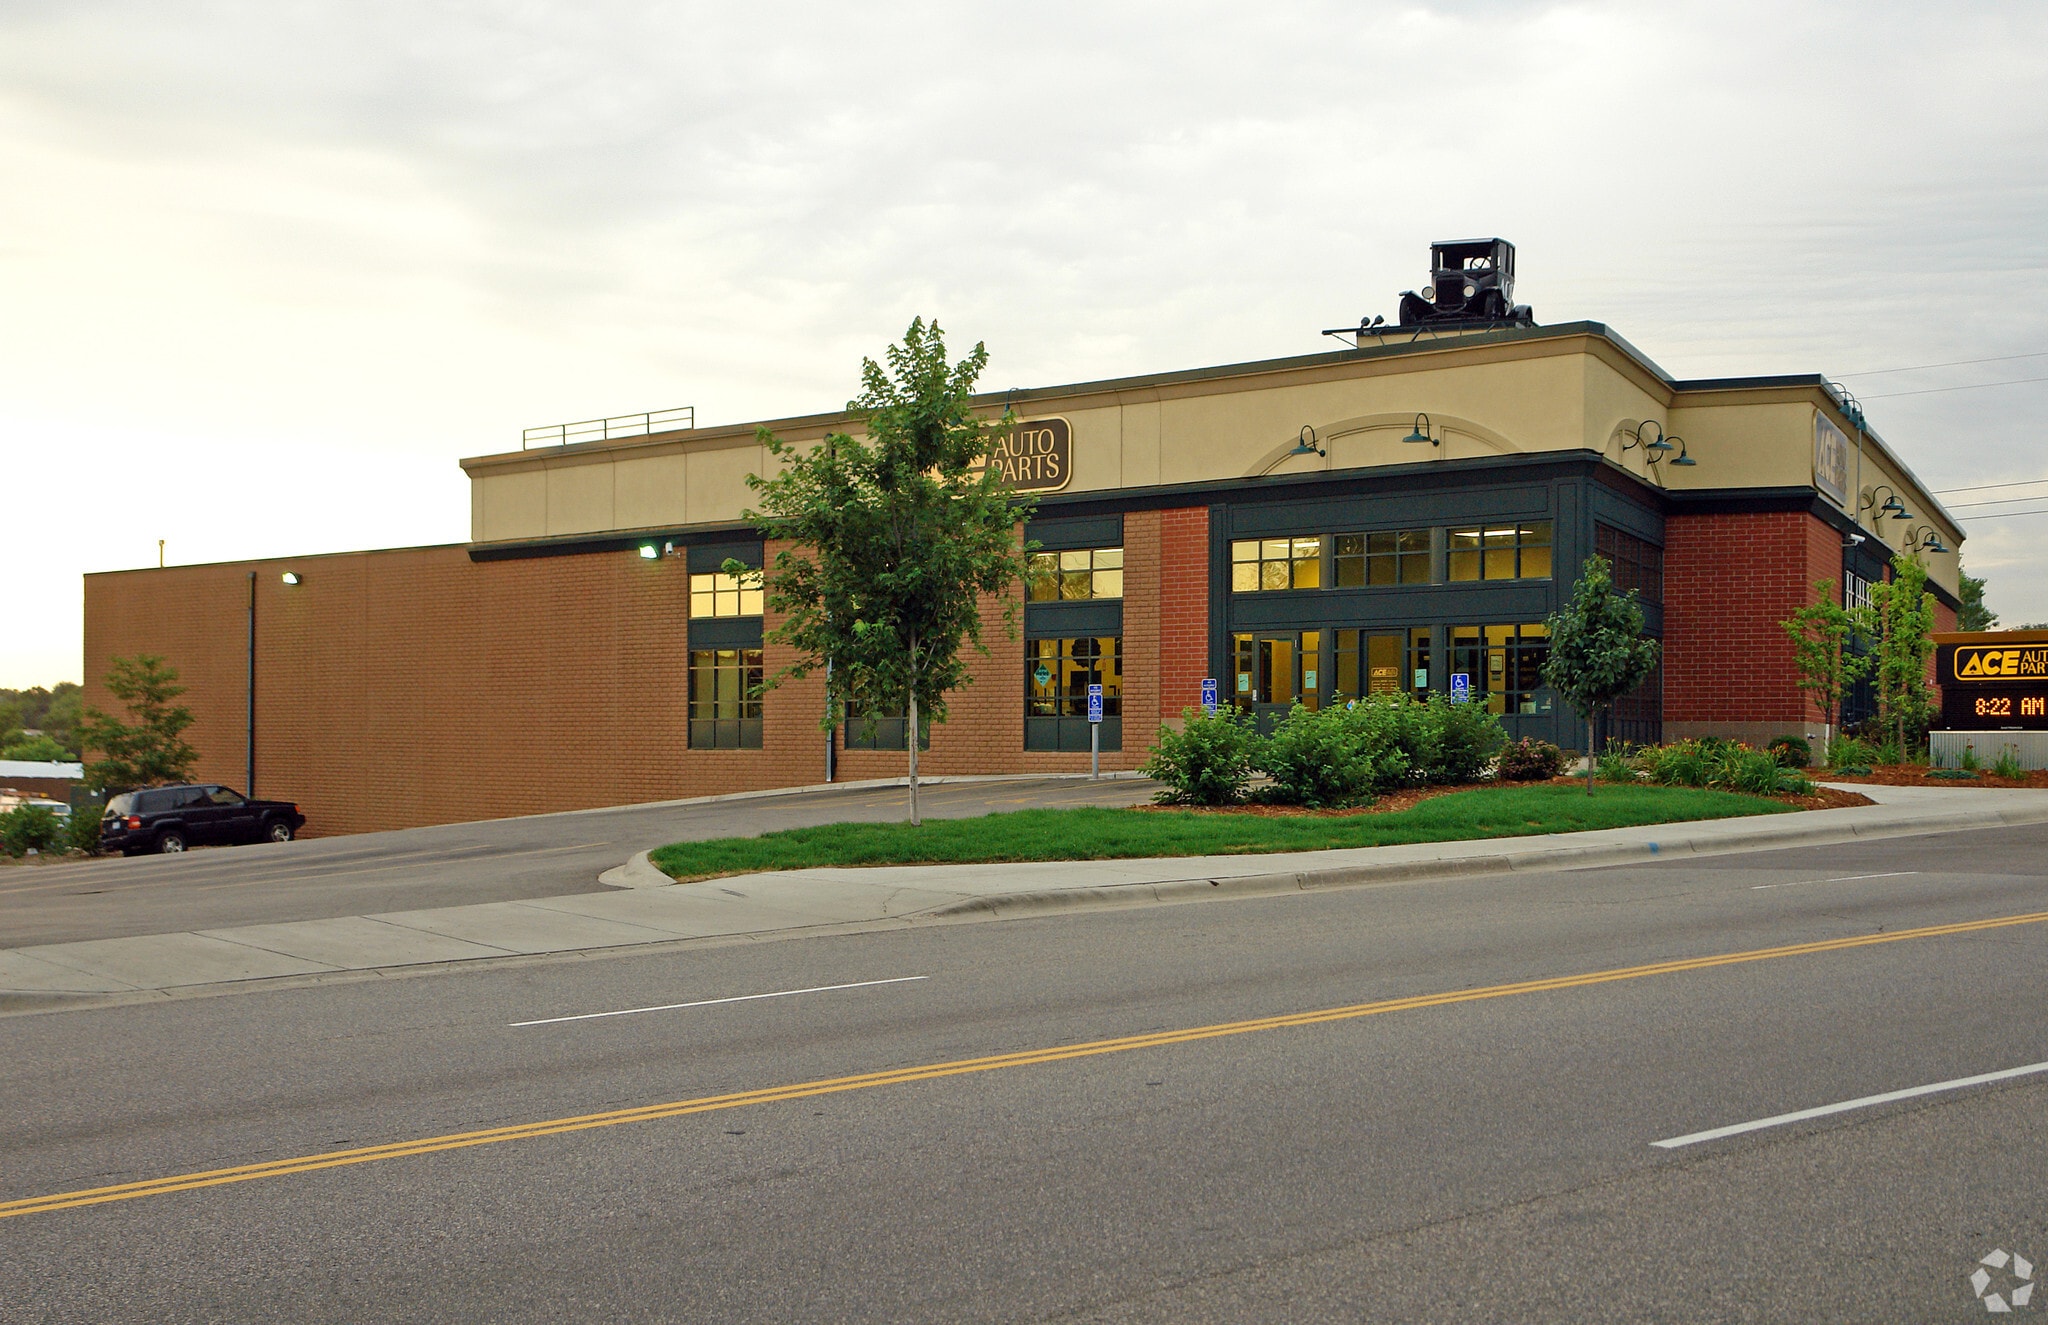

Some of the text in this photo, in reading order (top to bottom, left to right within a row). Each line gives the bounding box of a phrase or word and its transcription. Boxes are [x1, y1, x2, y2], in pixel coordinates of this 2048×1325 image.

[994, 428, 1055, 457] AUTO
[991, 453, 1060, 483] PARTS
[1960, 650, 2021, 676] ACE
[2020, 661, 2048, 675] PAR
[1975, 697, 2045, 716] 8:22 AM
